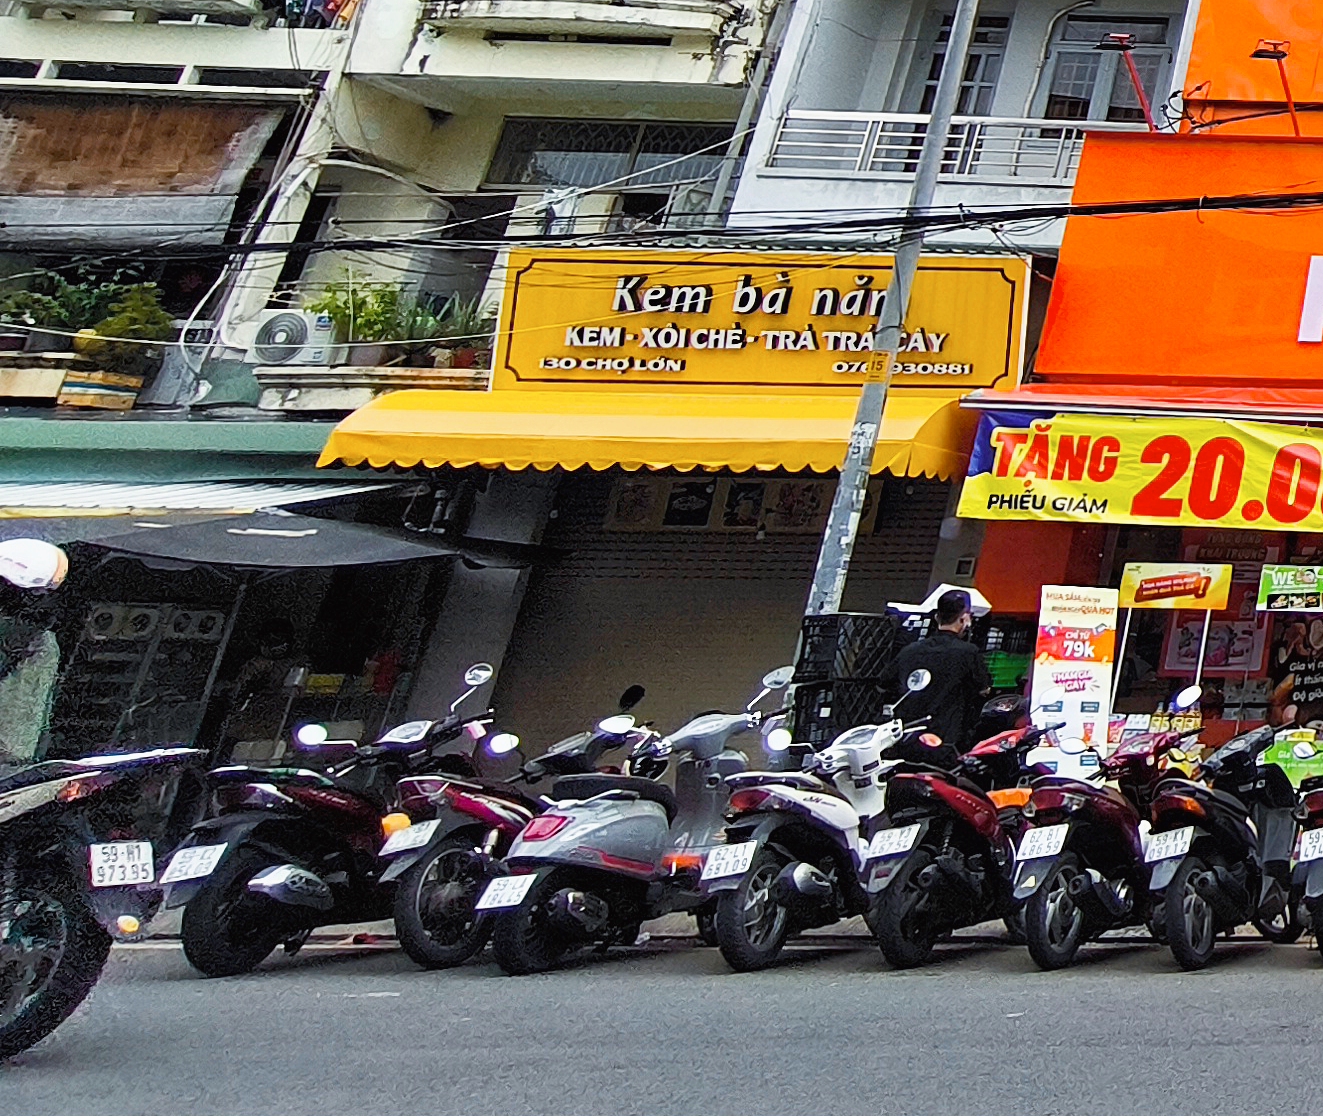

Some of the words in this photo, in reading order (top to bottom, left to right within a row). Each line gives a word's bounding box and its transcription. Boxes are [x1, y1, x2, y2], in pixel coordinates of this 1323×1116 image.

[610, 275, 712, 314] Kem
[565, 327, 623, 350] KEM
[638, 326, 692, 350] XÔI
[694, 323, 745, 350] CHÈ
[822, 324, 876, 352] TRÁ
[539, 356, 579, 371] 130
[580, 354, 630, 374] CHỢ
[635, 354, 686, 372] LỚN
[993, 425, 1121, 490] TẶNG
[986, 486, 1048, 512] PHIẾU
[1052, 492, 1108, 515] GIẢM
[1063, 640, 1095, 658] 79k
